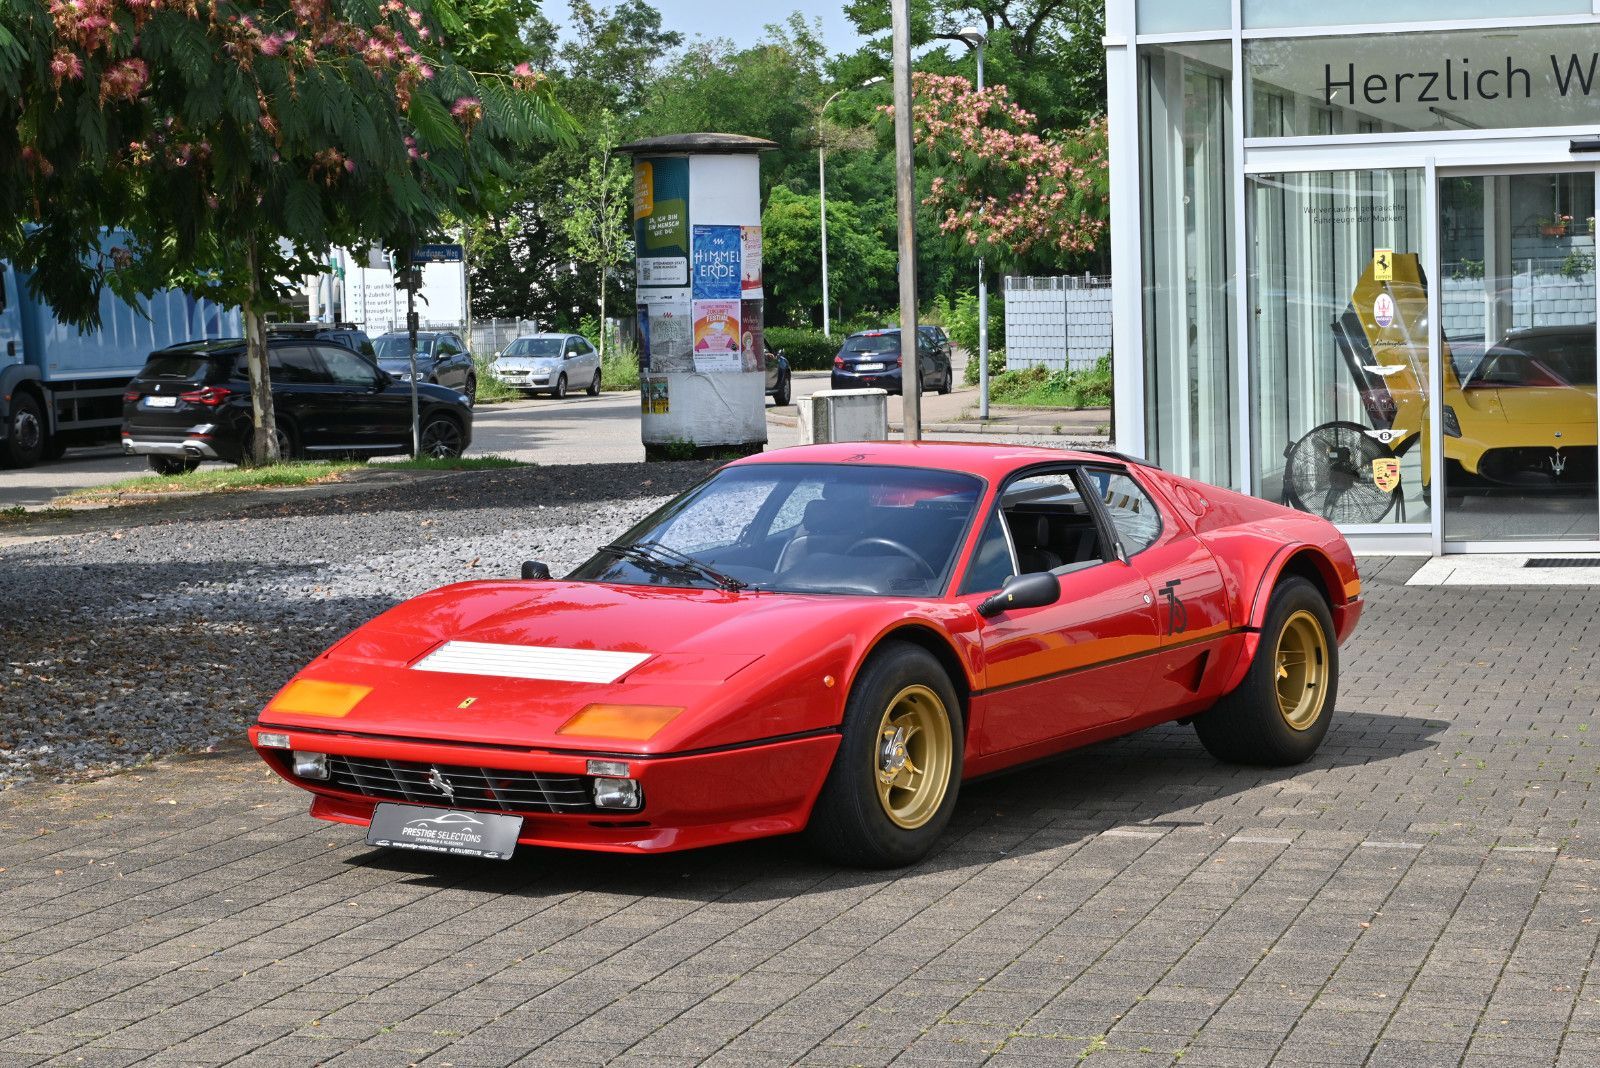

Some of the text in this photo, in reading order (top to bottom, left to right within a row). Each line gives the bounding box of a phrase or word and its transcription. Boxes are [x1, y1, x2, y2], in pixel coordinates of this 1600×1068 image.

[1325, 53, 1599, 105] Herzlich W
[1319, 205, 1357, 213] verkaufen
[1361, 203, 1405, 214] gebrauchte
[1313, 216, 1355, 225] Fahrzeuge
[1357, 215, 1370, 223] der
[446, 249, 459, 258] Weg
[694, 249, 740, 265] HIMMEL
[701, 265, 736, 279] ERDE
[402, 827, 482, 843] PRESTIGE SELECTIONS
